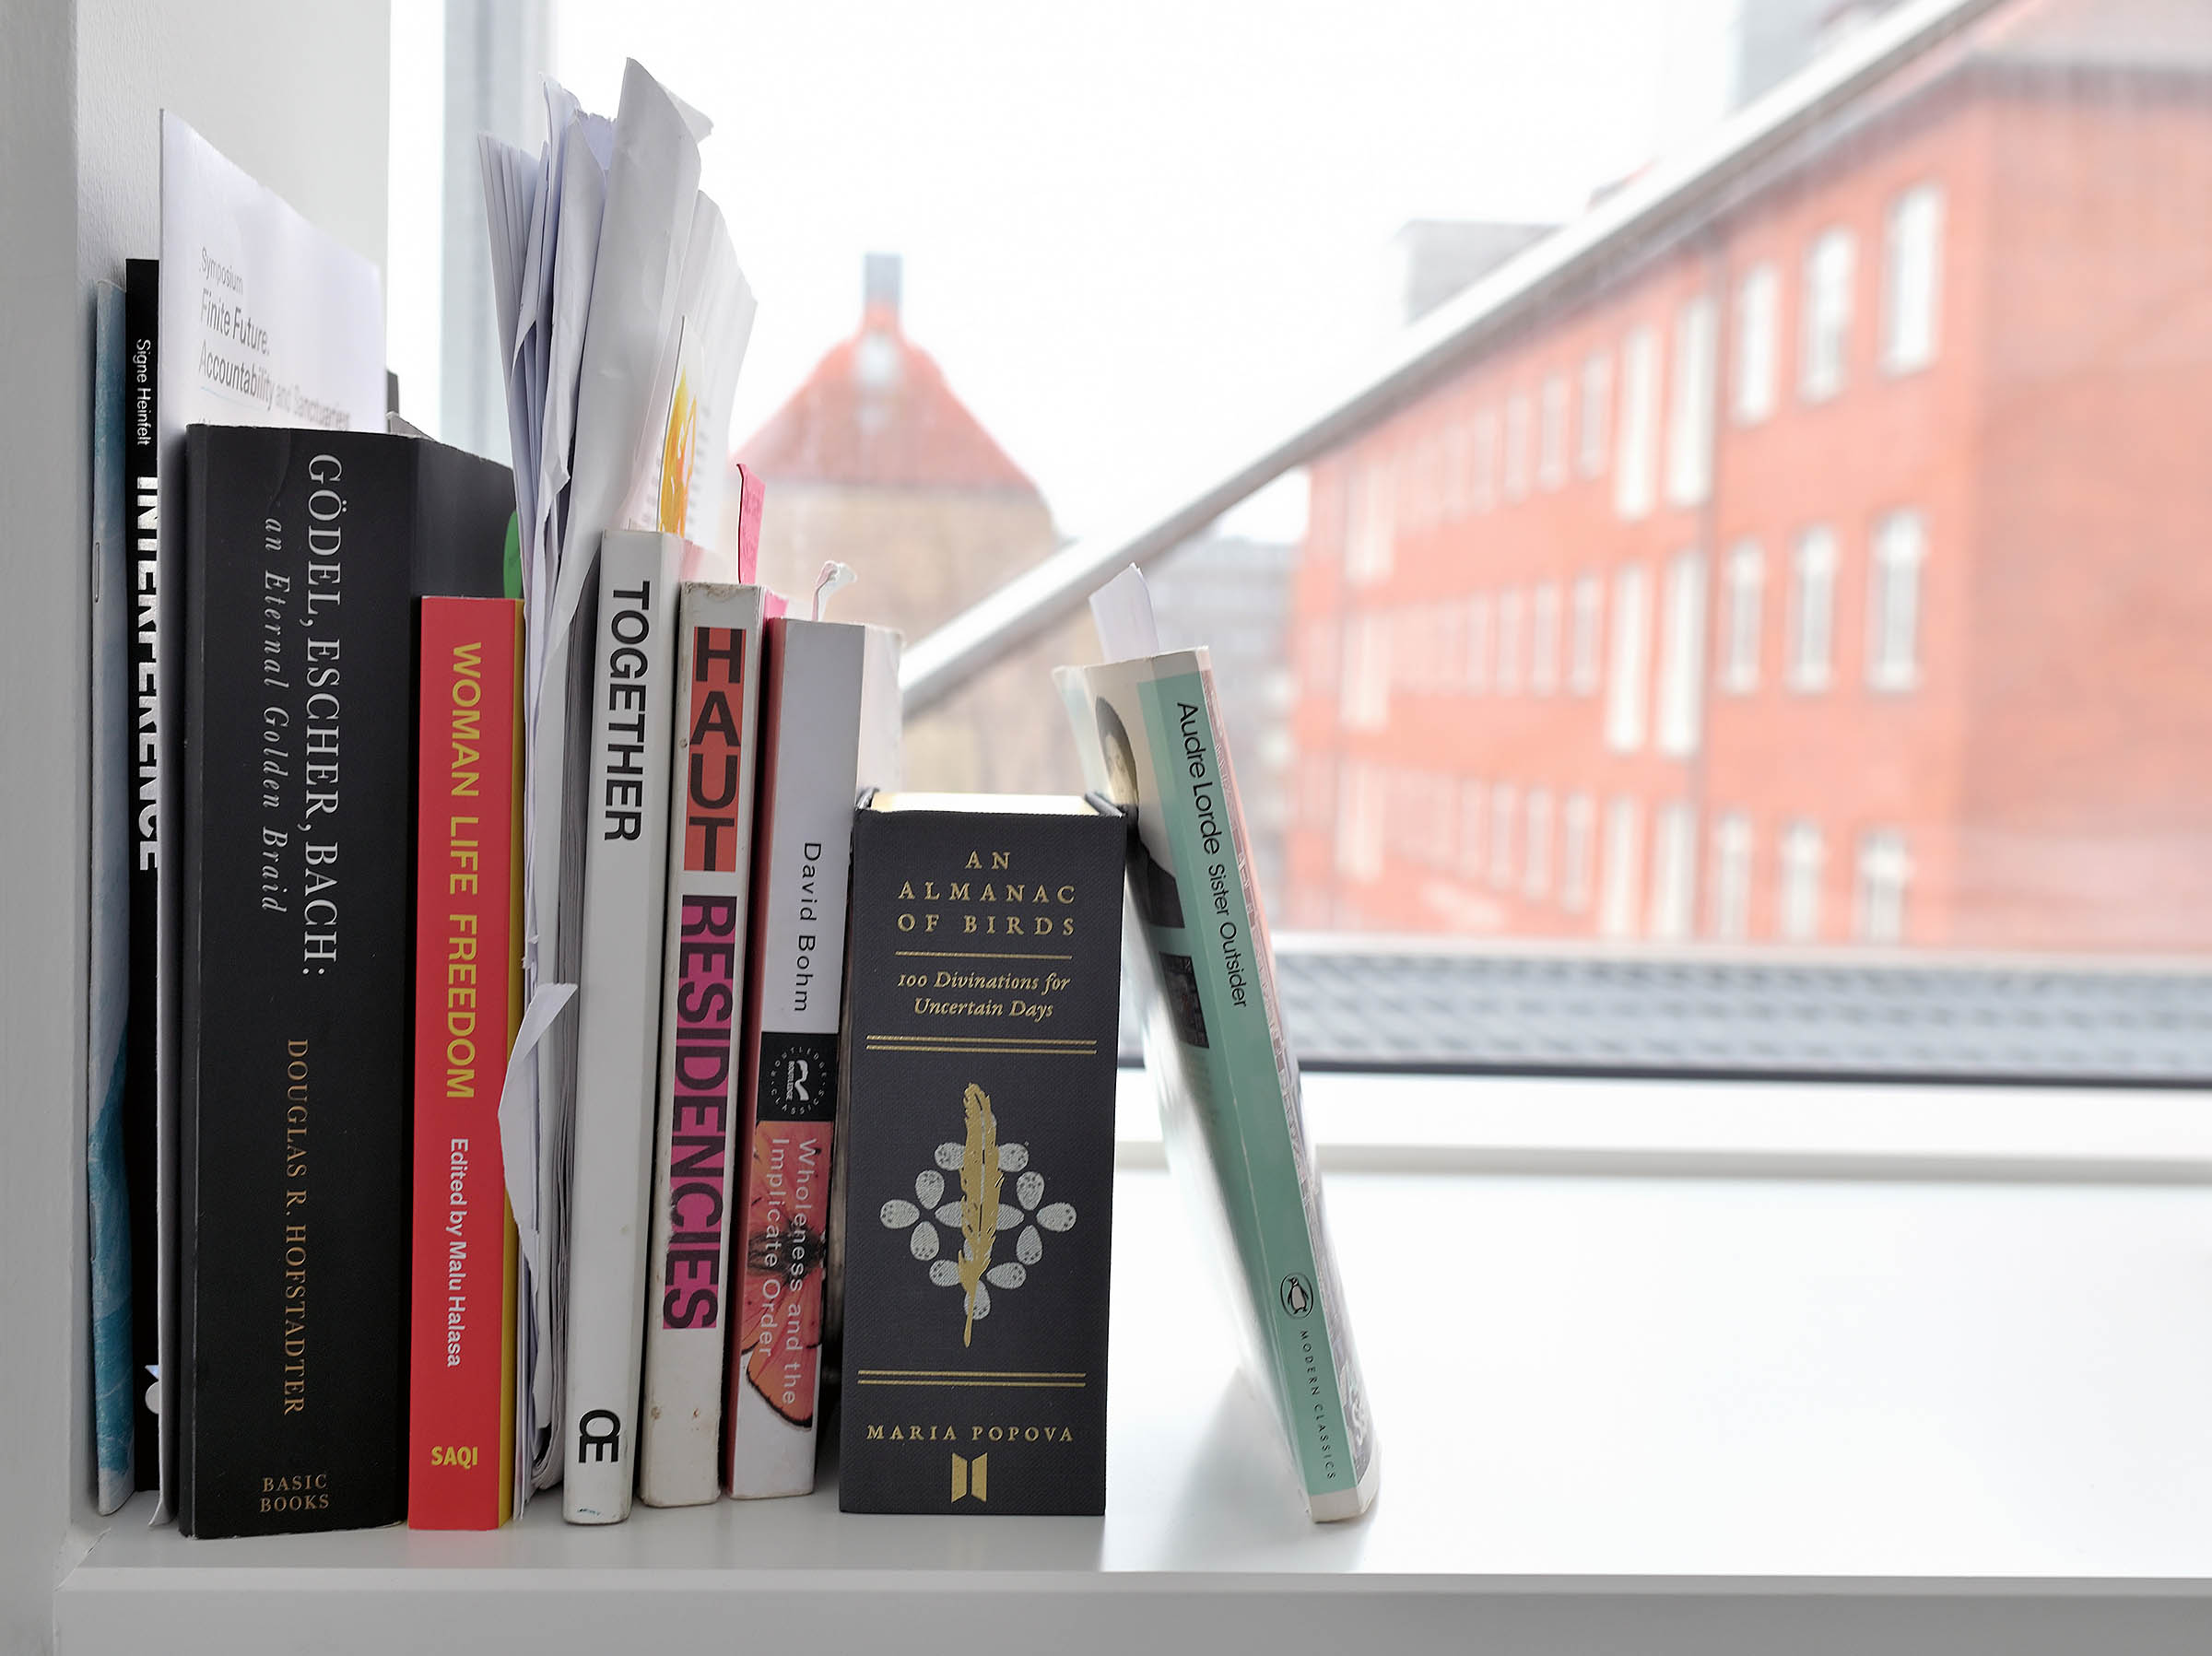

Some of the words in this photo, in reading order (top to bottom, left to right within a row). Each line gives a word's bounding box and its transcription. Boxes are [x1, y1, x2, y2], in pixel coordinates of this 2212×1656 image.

[201, 246, 243, 296] Symposium
[200, 288, 230, 336] Finite
[133, 338, 151, 383] Signe
[199, 339, 276, 411] Accountability
[136, 387, 151, 445] Heinfelt
[265, 517, 282, 552] an
[300, 453, 347, 627] GÖDEL,
[263, 570, 291, 687] Eternal
[298, 638, 340, 831] ESCHER,
[451, 641, 482, 797] WOMAN
[604, 580, 651, 842] TOGETHER
[1176, 701, 1207, 779] Audre
[262, 705, 289, 808] Golden
[689, 627, 742, 871] HAUT
[1192, 781, 1221, 855] Lorde
[261, 826, 288, 912] Braid
[449, 816, 479, 896] LIFE
[799, 841, 822, 922] David
[898, 880, 1076, 904] ALMANAC
[965, 850, 1011, 870] AN
[1207, 863, 1230, 917] Sister
[301, 841, 338, 975] BACH:
[897, 913, 940, 934] OF
[963, 915, 1075, 936] BIRDS
[794, 934, 817, 1012] Bohm
[898, 973, 928, 988] 100
[934, 971, 1039, 991] Divinations
[1041, 972, 1071, 995] for
[1218, 922, 1247, 1008] Outsider
[446, 914, 477, 1100] FREEDOM
[913, 997, 1004, 1016] Uncertain
[1009, 1000, 1054, 1023] Days
[285, 1039, 309, 1178] DOUGLAS
[663, 895, 737, 1329] RESIDENCIES
[284, 1191, 308, 1216] R.
[449, 1137, 469, 1206] Edited
[765, 1138, 790, 1268] Implicate
[445, 1210, 468, 1239] by
[789, 1138, 818, 1294] Wholeness
[448, 1240, 467, 1292] Malu
[283, 1224, 308, 1416] HOFSTADTER
[447, 1295, 466, 1368] Halasa
[759, 1278, 782, 1357] Order
[787, 1301, 804, 1353] and
[783, 1358, 803, 1405] the
[1299, 1330, 1321, 1396] MODERN
[1313, 1403, 1336, 1480] CLASSICS
[430, 1445, 478, 1469] SAQI
[866, 1424, 958, 1441] MARIA
[971, 1426, 1075, 1442] POPOVA
[259, 1494, 330, 1513] BOOKS
[262, 1474, 328, 1494] BASIC
